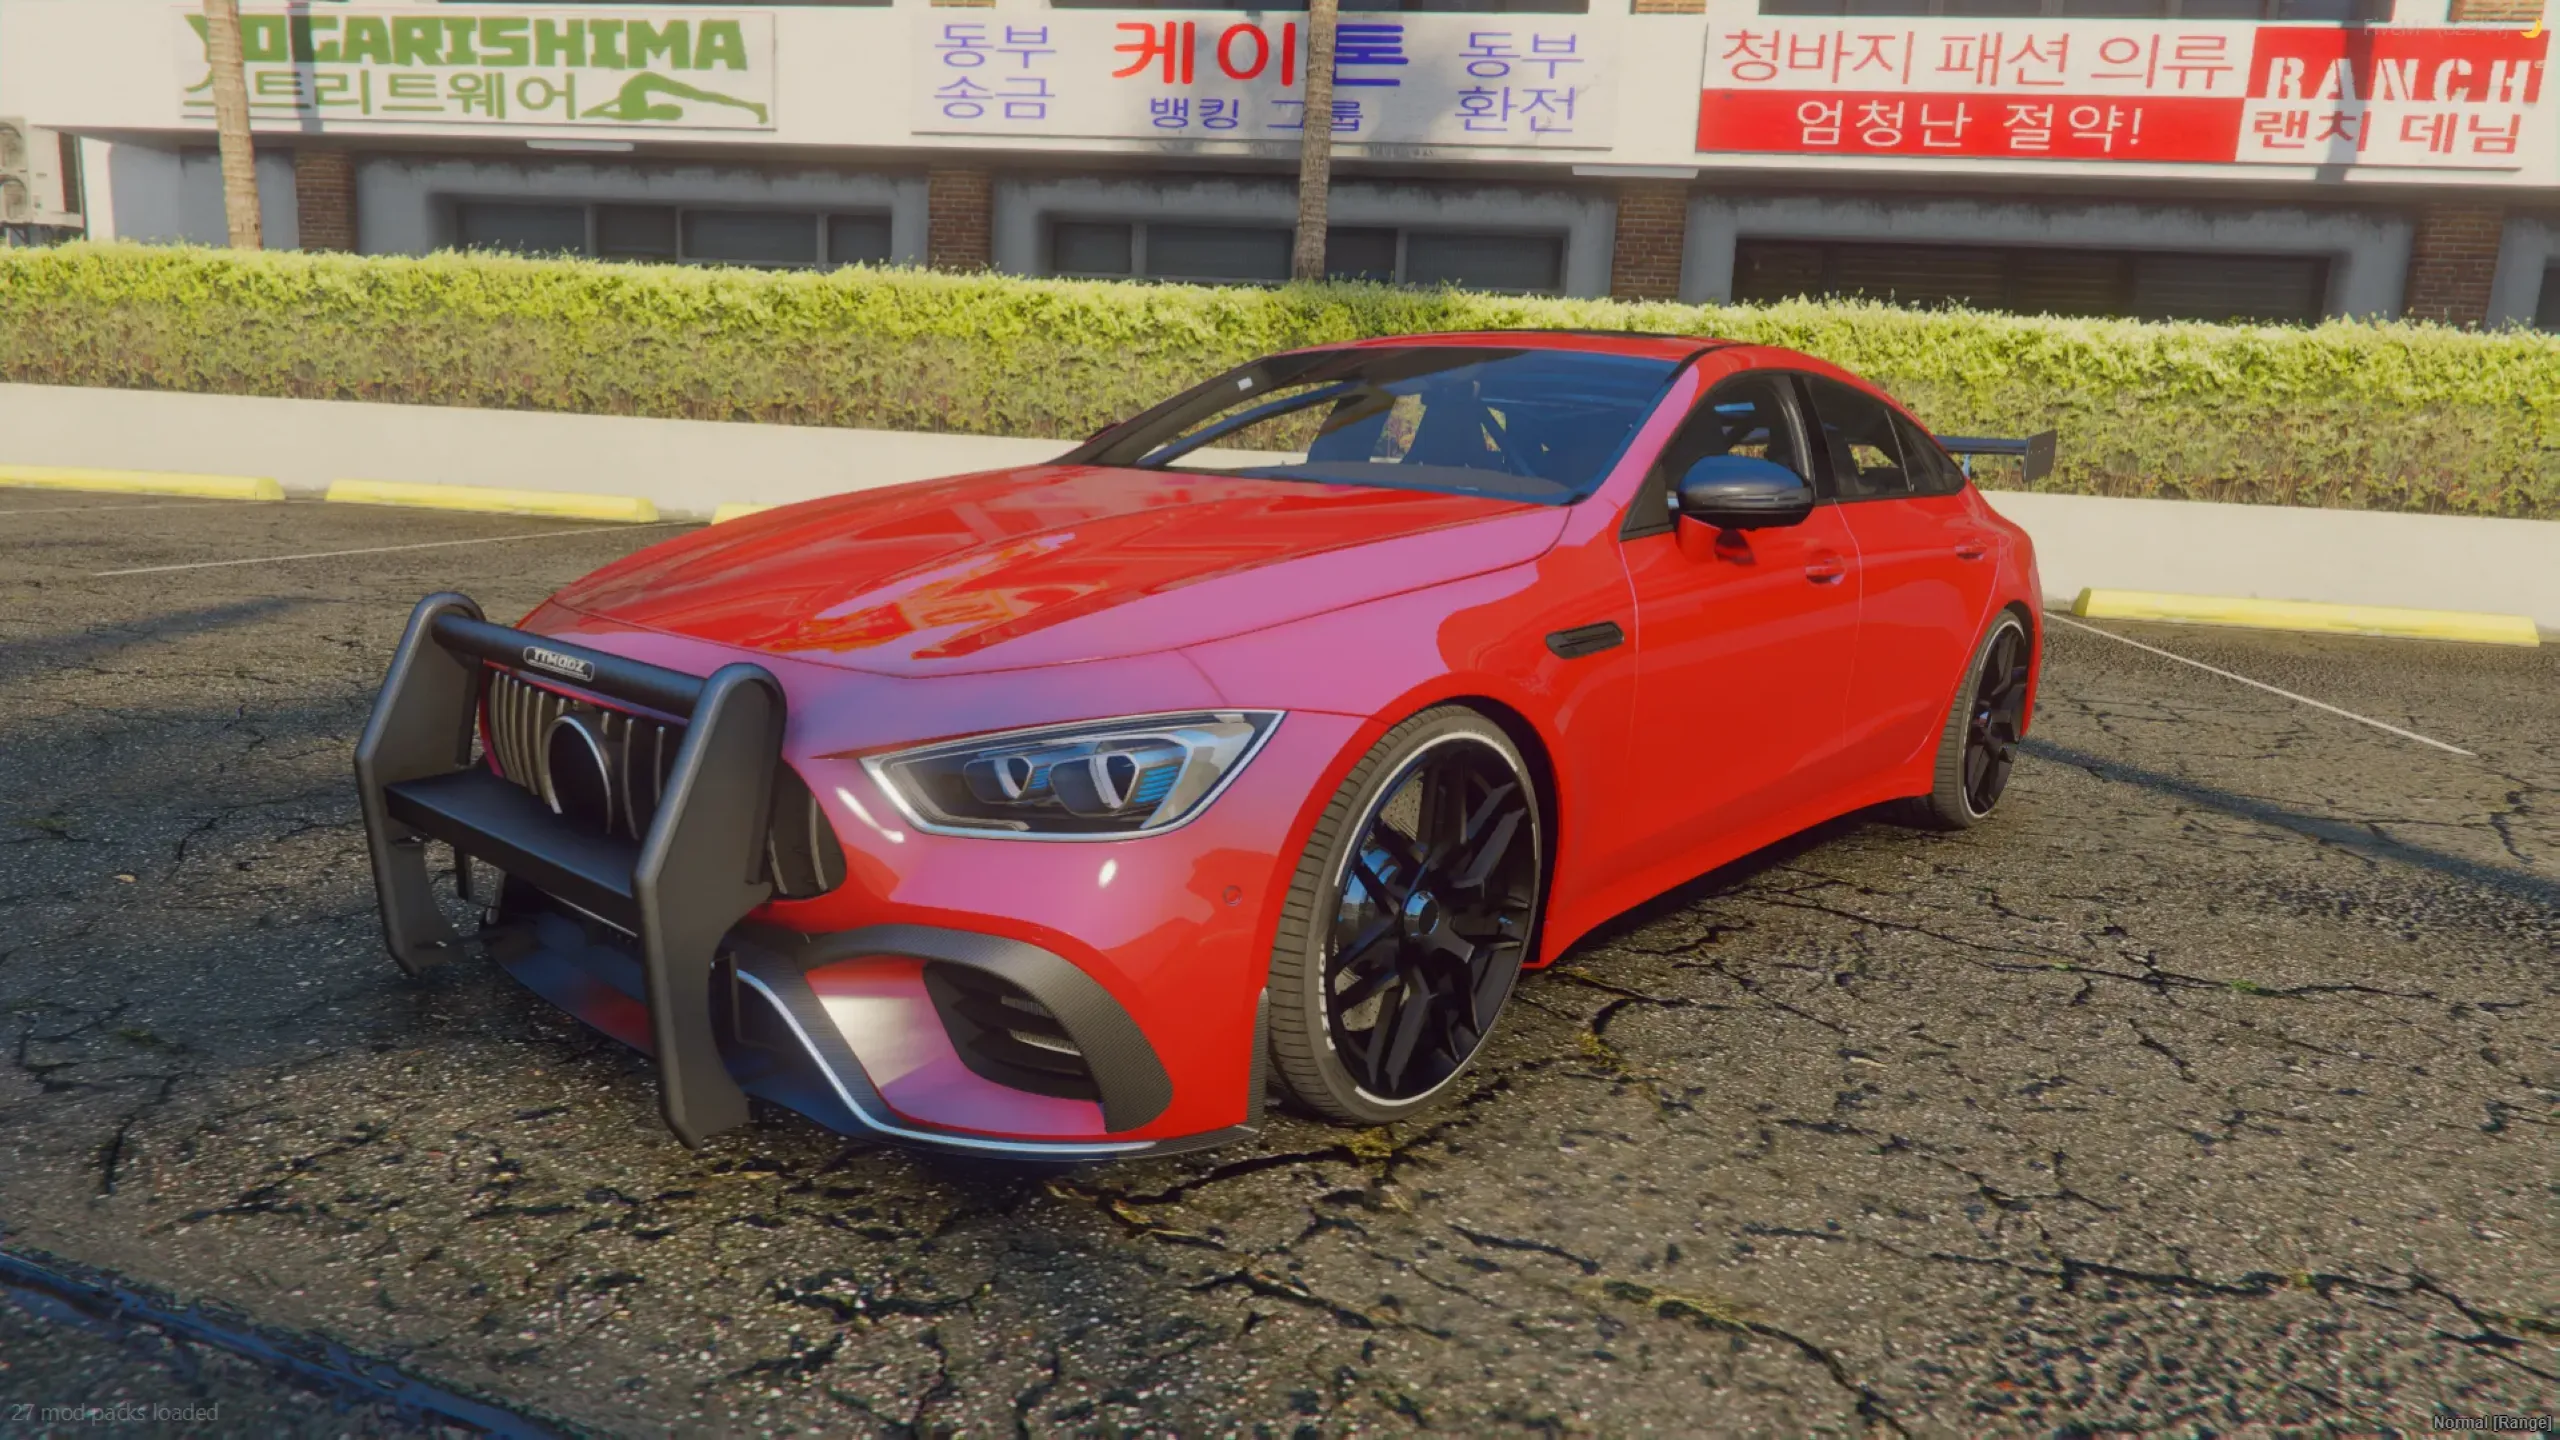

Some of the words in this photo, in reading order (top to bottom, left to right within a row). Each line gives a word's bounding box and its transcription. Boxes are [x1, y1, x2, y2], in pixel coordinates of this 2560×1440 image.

[934, 23, 1057, 69] 동부
[1458, 31, 1585, 79] 동부
[1721, 28, 1915, 85] 청바지
[1934, 31, 2070, 87] 패션
[2090, 33, 2234, 90] 의류
[933, 75, 1056, 120] 송금
[2264, 57, 2532, 104] RANCH
[1150, 97, 1240, 130] 뱅킹
[1454, 85, 1576, 132] 환전
[1797, 99, 1973, 147] 엄청난
[2002, 103, 2143, 153] 절약!
[2253, 109, 2372, 152] 랜치
[2399, 111, 2522, 154] 데님
